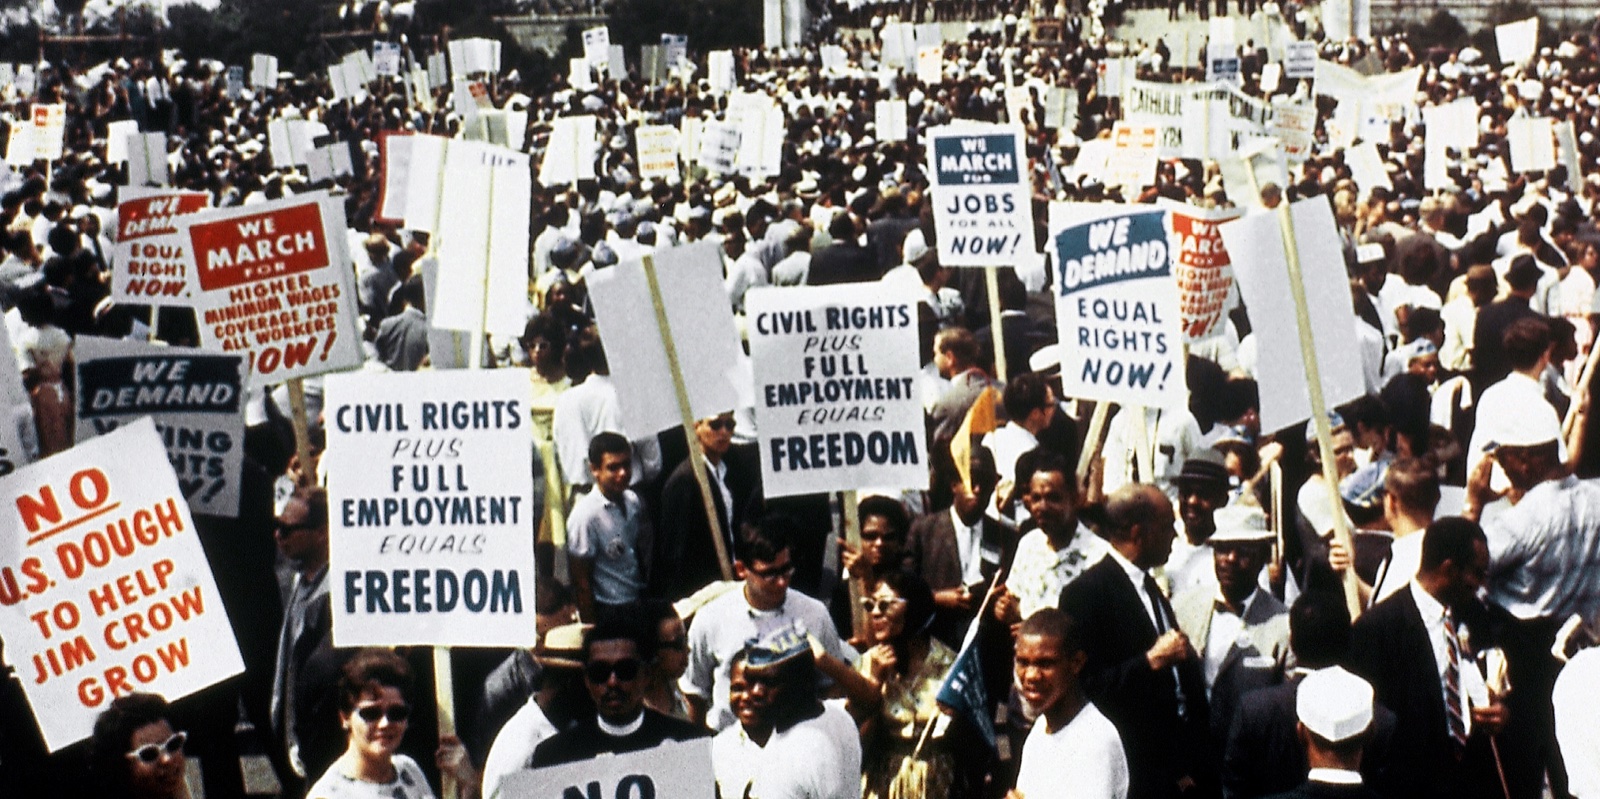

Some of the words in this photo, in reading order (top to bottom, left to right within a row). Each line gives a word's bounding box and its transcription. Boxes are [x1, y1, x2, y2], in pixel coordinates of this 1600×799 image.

[961, 137, 987, 152] WE
[941, 153, 1013, 173] MARCH
[148, 197, 181, 214] WE
[947, 193, 1015, 214] JOBS
[237, 217, 276, 238] WE
[949, 220, 978, 228] FOR
[988, 220, 1015, 228] ALL
[1088, 217, 1131, 252] WE
[207, 231, 316, 270] MARCH
[951, 233, 1021, 255] NOW!
[244, 262, 286, 278] FOR
[1064, 239, 1168, 289] DEMAND
[230, 274, 312, 303] HIGHER
[204, 296, 282, 324] MINIMUM
[287, 283, 341, 307] WAGES
[1078, 298, 1163, 324] EQUAL
[215, 310, 300, 338] COVERAGE
[307, 301, 339, 319] FOR
[223, 333, 251, 352] ALL
[256, 316, 336, 344] WORKERS
[756, 310, 817, 336] CIVIL
[825, 305, 910, 331] RIGHTS
[804, 335, 862, 353] PLUS
[1078, 327, 1168, 354] RIGHTS
[133, 359, 192, 382] WE
[804, 354, 868, 378] FULL
[1081, 358, 1172, 391] NOW!
[92, 383, 234, 409] DEMAND
[764, 378, 914, 407] EMPLOYMENT
[336, 403, 409, 433] CIVIL
[422, 400, 521, 430] RIGHTS
[797, 405, 886, 425] EQUALS
[92, 417, 232, 453] VING
[392, 437, 463, 458] PLUS
[770, 430, 919, 472] FREEDOM
[392, 464, 469, 493] FULL
[16, 467, 110, 534] NO
[342, 495, 522, 527] EMPLOYMENT
[0, 556, 57, 606] U.S.
[56, 497, 185, 580] DOUGH
[379, 533, 487, 555] EQUALS
[31, 601, 81, 640] TO
[89, 558, 176, 618] HELP
[344, 568, 523, 614] FREEDOM
[31, 635, 97, 685] JIM
[103, 586, 206, 651] CROW
[78, 637, 191, 708] GROW
